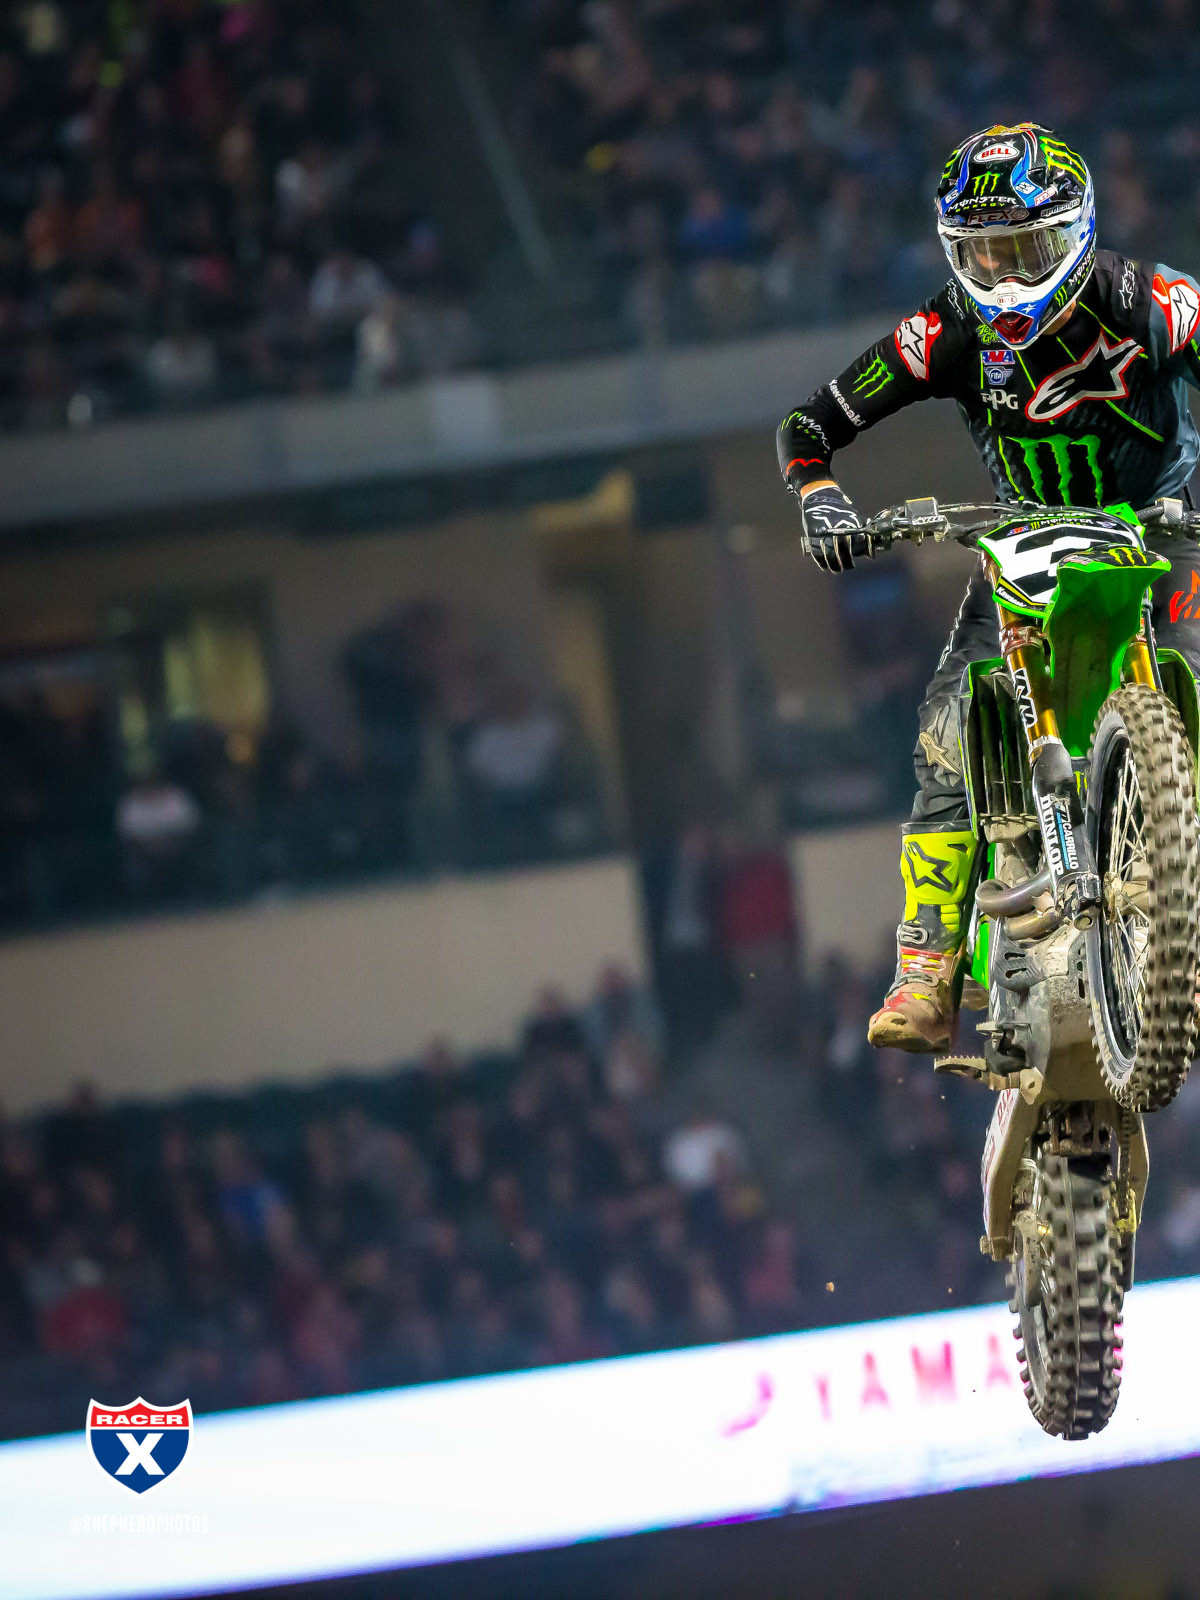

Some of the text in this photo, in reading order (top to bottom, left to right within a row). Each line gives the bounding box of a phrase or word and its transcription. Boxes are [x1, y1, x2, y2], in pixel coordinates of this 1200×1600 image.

[981, 148, 1012, 158] BELL
[948, 196, 1017, 212] MONSTER
[1040, 794, 1064, 875] DUNLOP
[1063, 822, 1079, 869] CARRILLO
